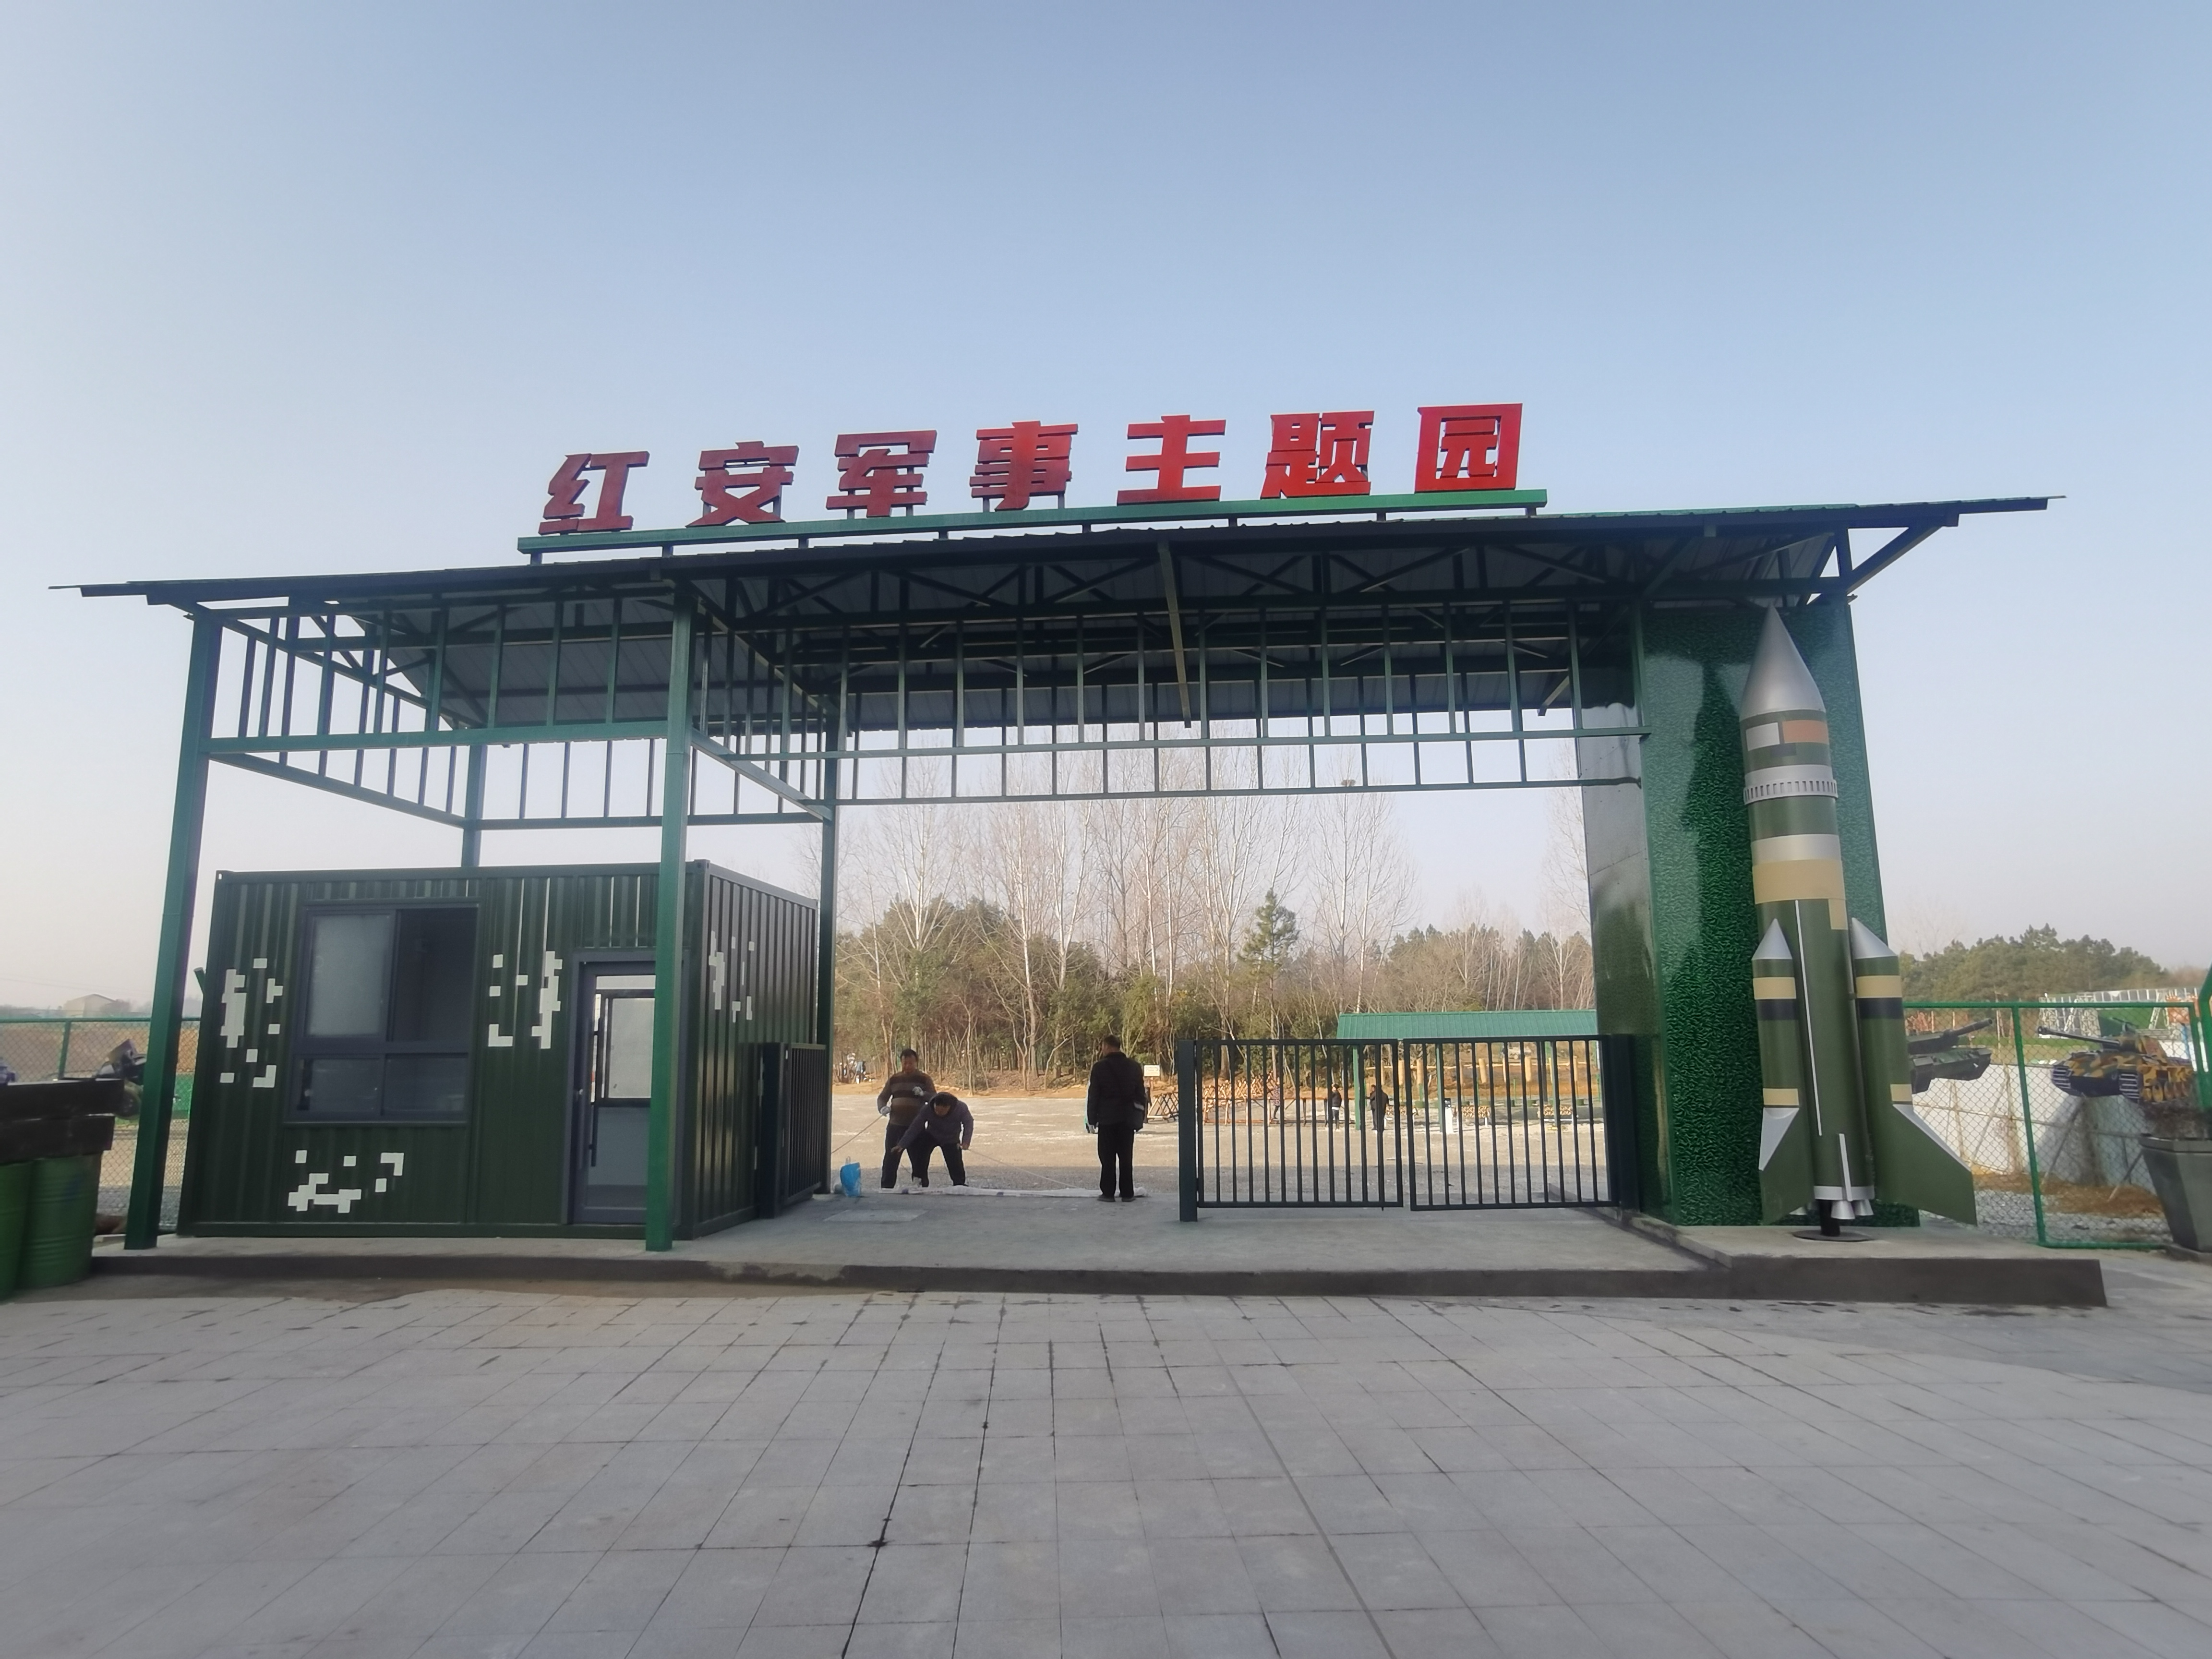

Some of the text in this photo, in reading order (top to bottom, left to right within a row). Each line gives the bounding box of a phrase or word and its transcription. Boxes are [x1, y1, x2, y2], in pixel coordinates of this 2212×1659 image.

[538, 403, 1523, 535] 红安军事主题园
